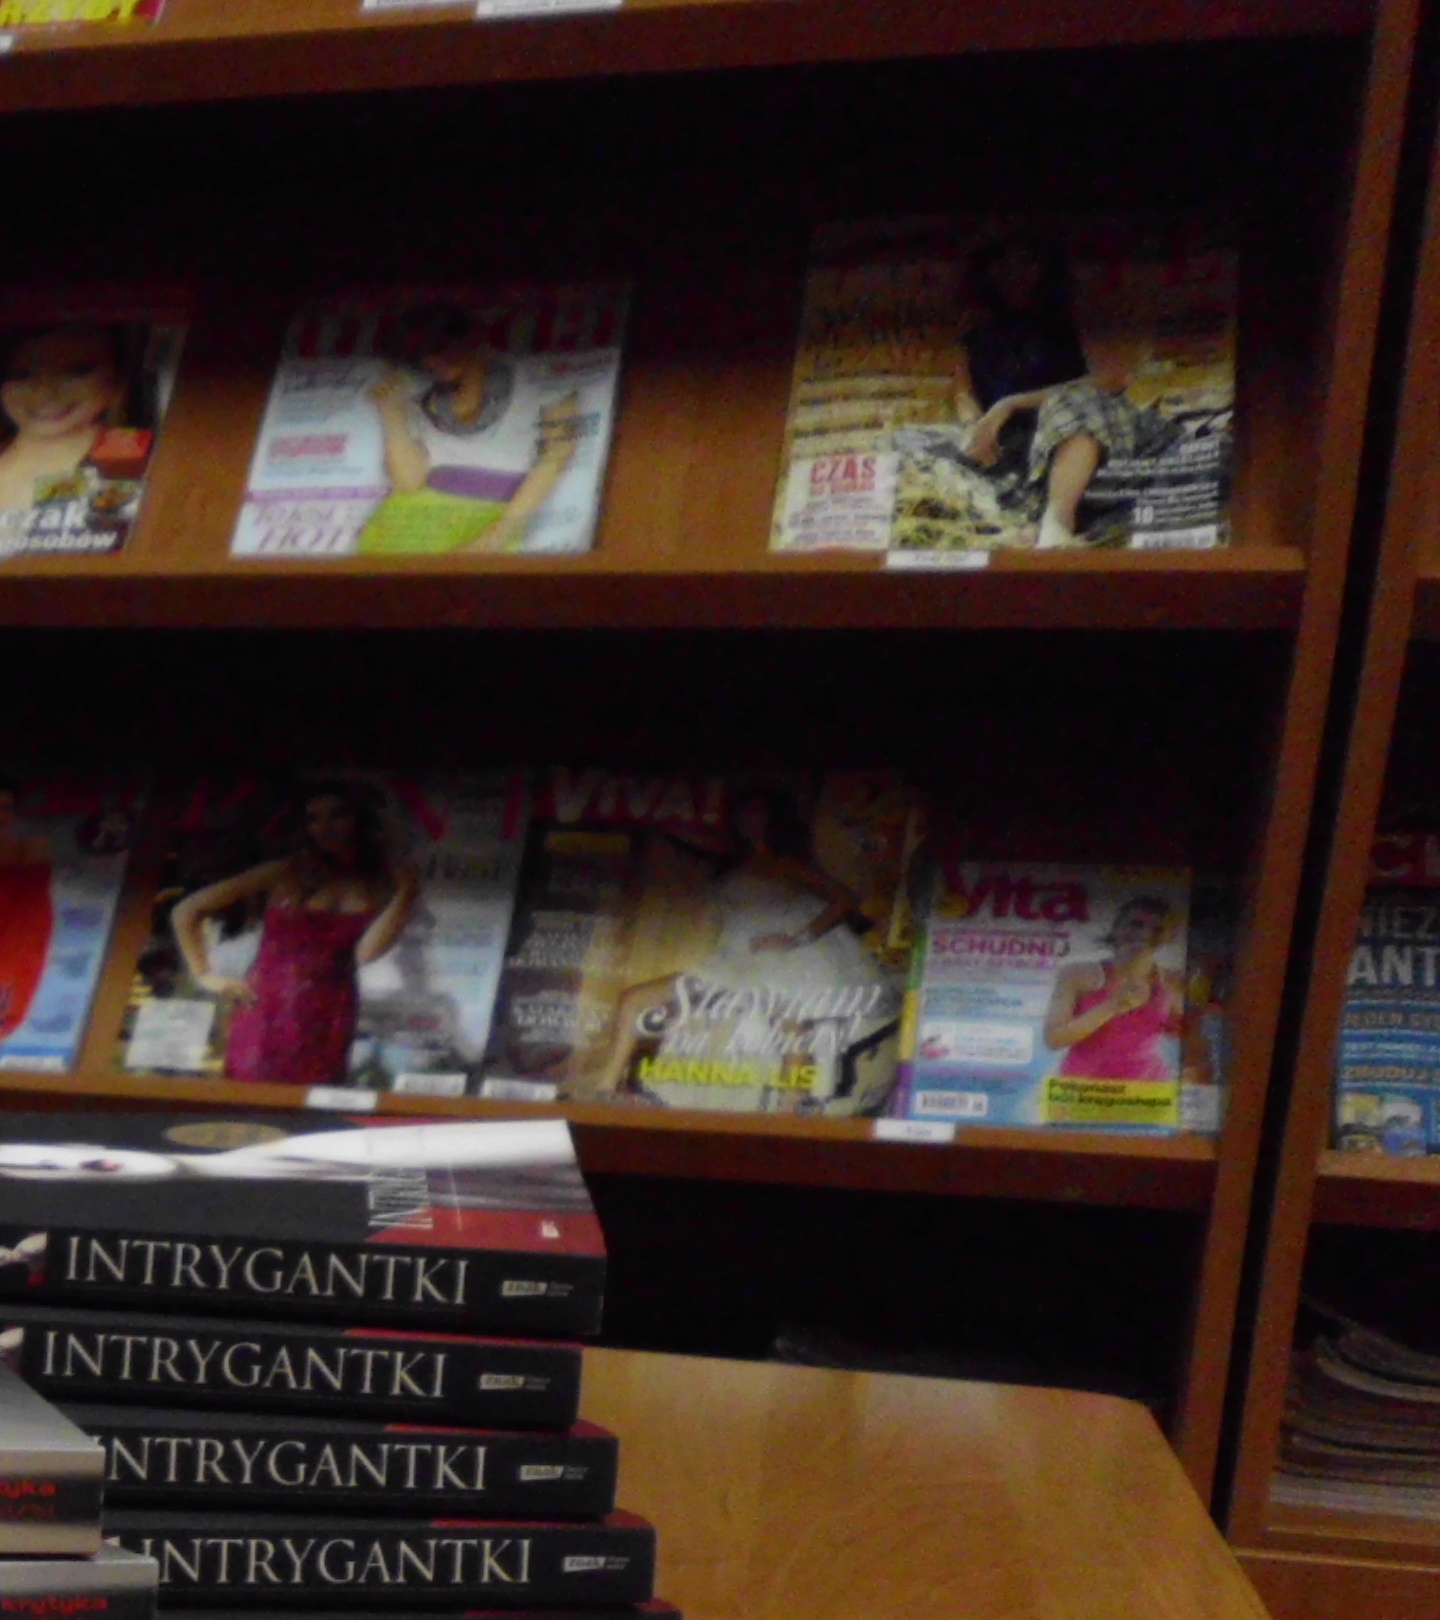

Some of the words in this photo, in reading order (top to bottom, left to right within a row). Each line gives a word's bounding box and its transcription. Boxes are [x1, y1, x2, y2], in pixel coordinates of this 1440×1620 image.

[811, 454, 877, 485] CZAS
[553, 766, 724, 825] VIVA!
[639, 1056, 755, 1086] HANNA
[66, 1235, 470, 1306] INTRYGANTKI
[42, 1330, 449, 1399] INTRYGANTKI
[92, 1434, 488, 1491] NTRYGANTKI
